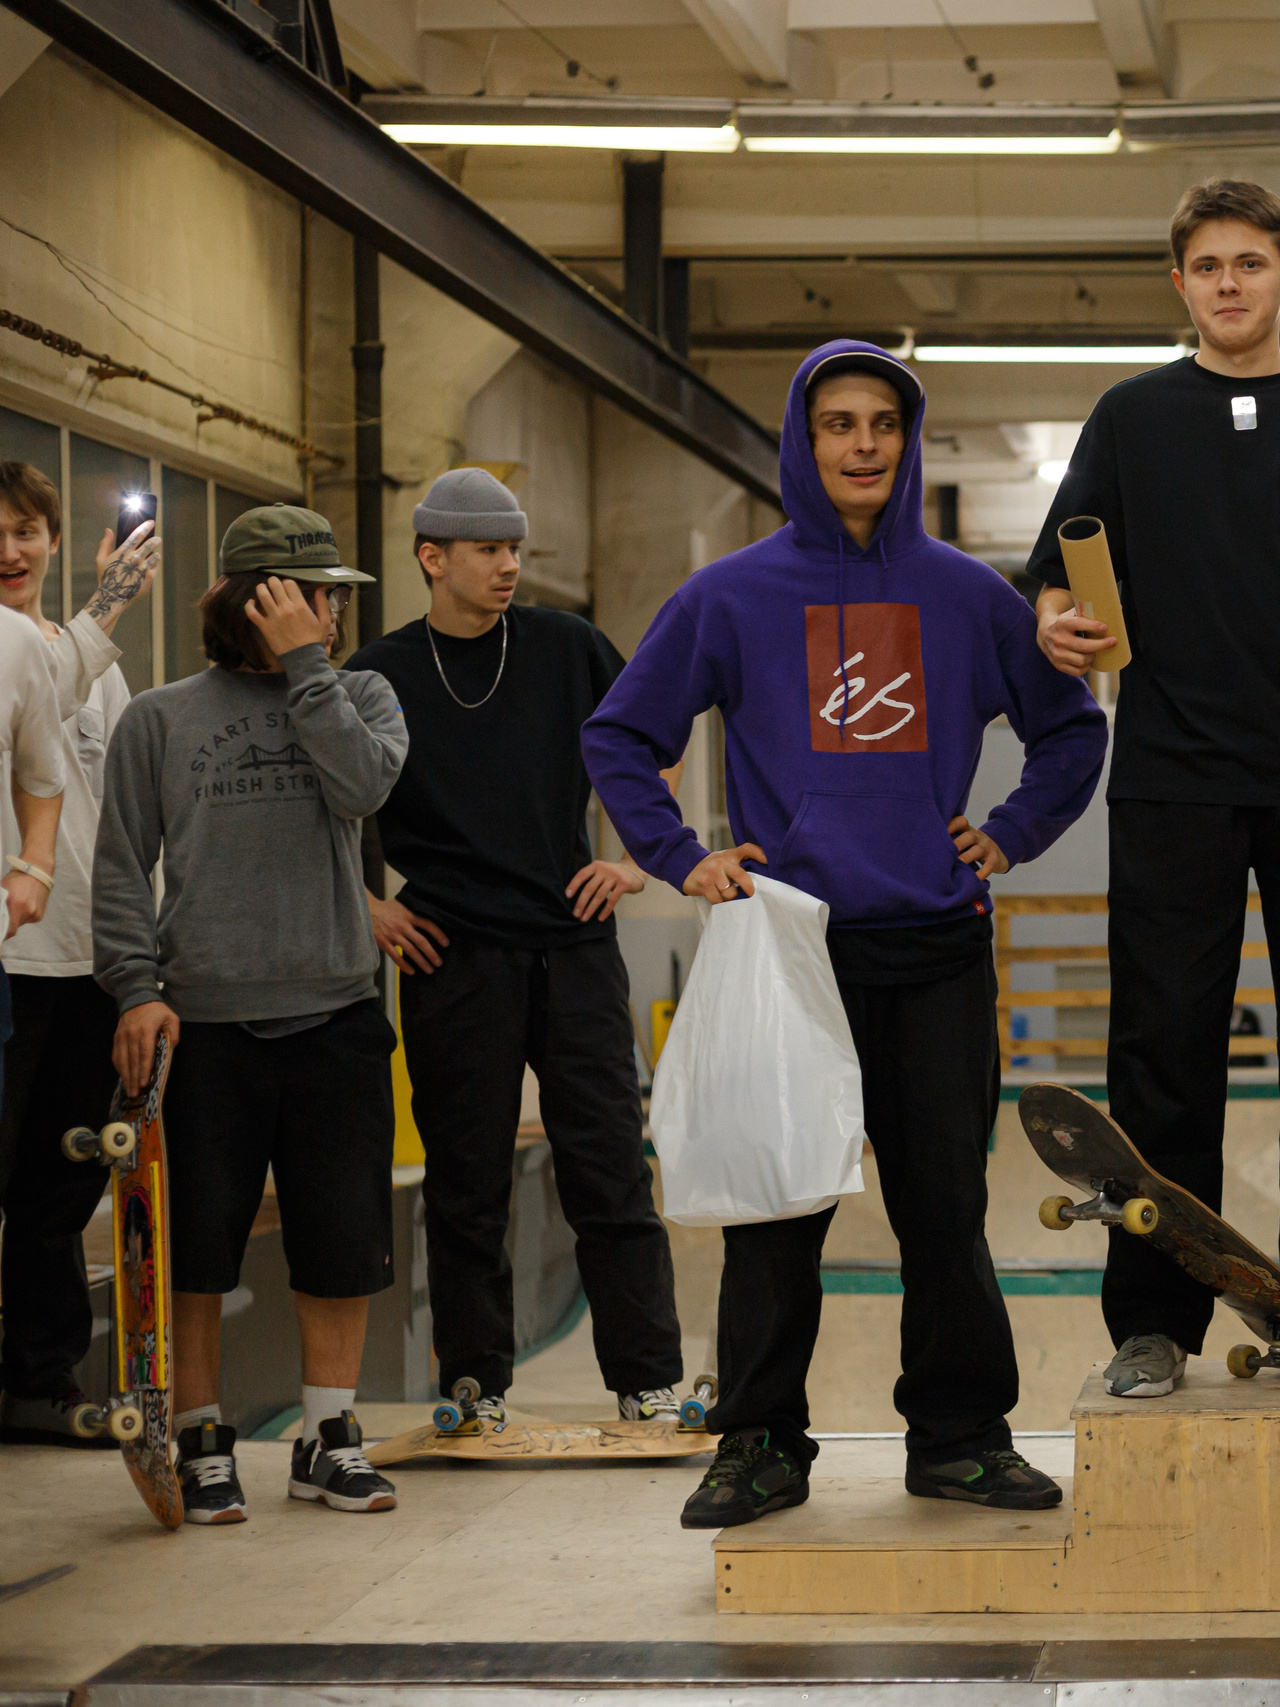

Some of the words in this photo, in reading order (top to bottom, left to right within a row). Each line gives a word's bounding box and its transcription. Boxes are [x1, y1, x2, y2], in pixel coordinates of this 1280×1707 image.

[190, 716, 251, 774] START
[265, 712, 297, 731] ST
[194, 777, 263, 803] FINISH
[274, 774, 321, 791] STR
